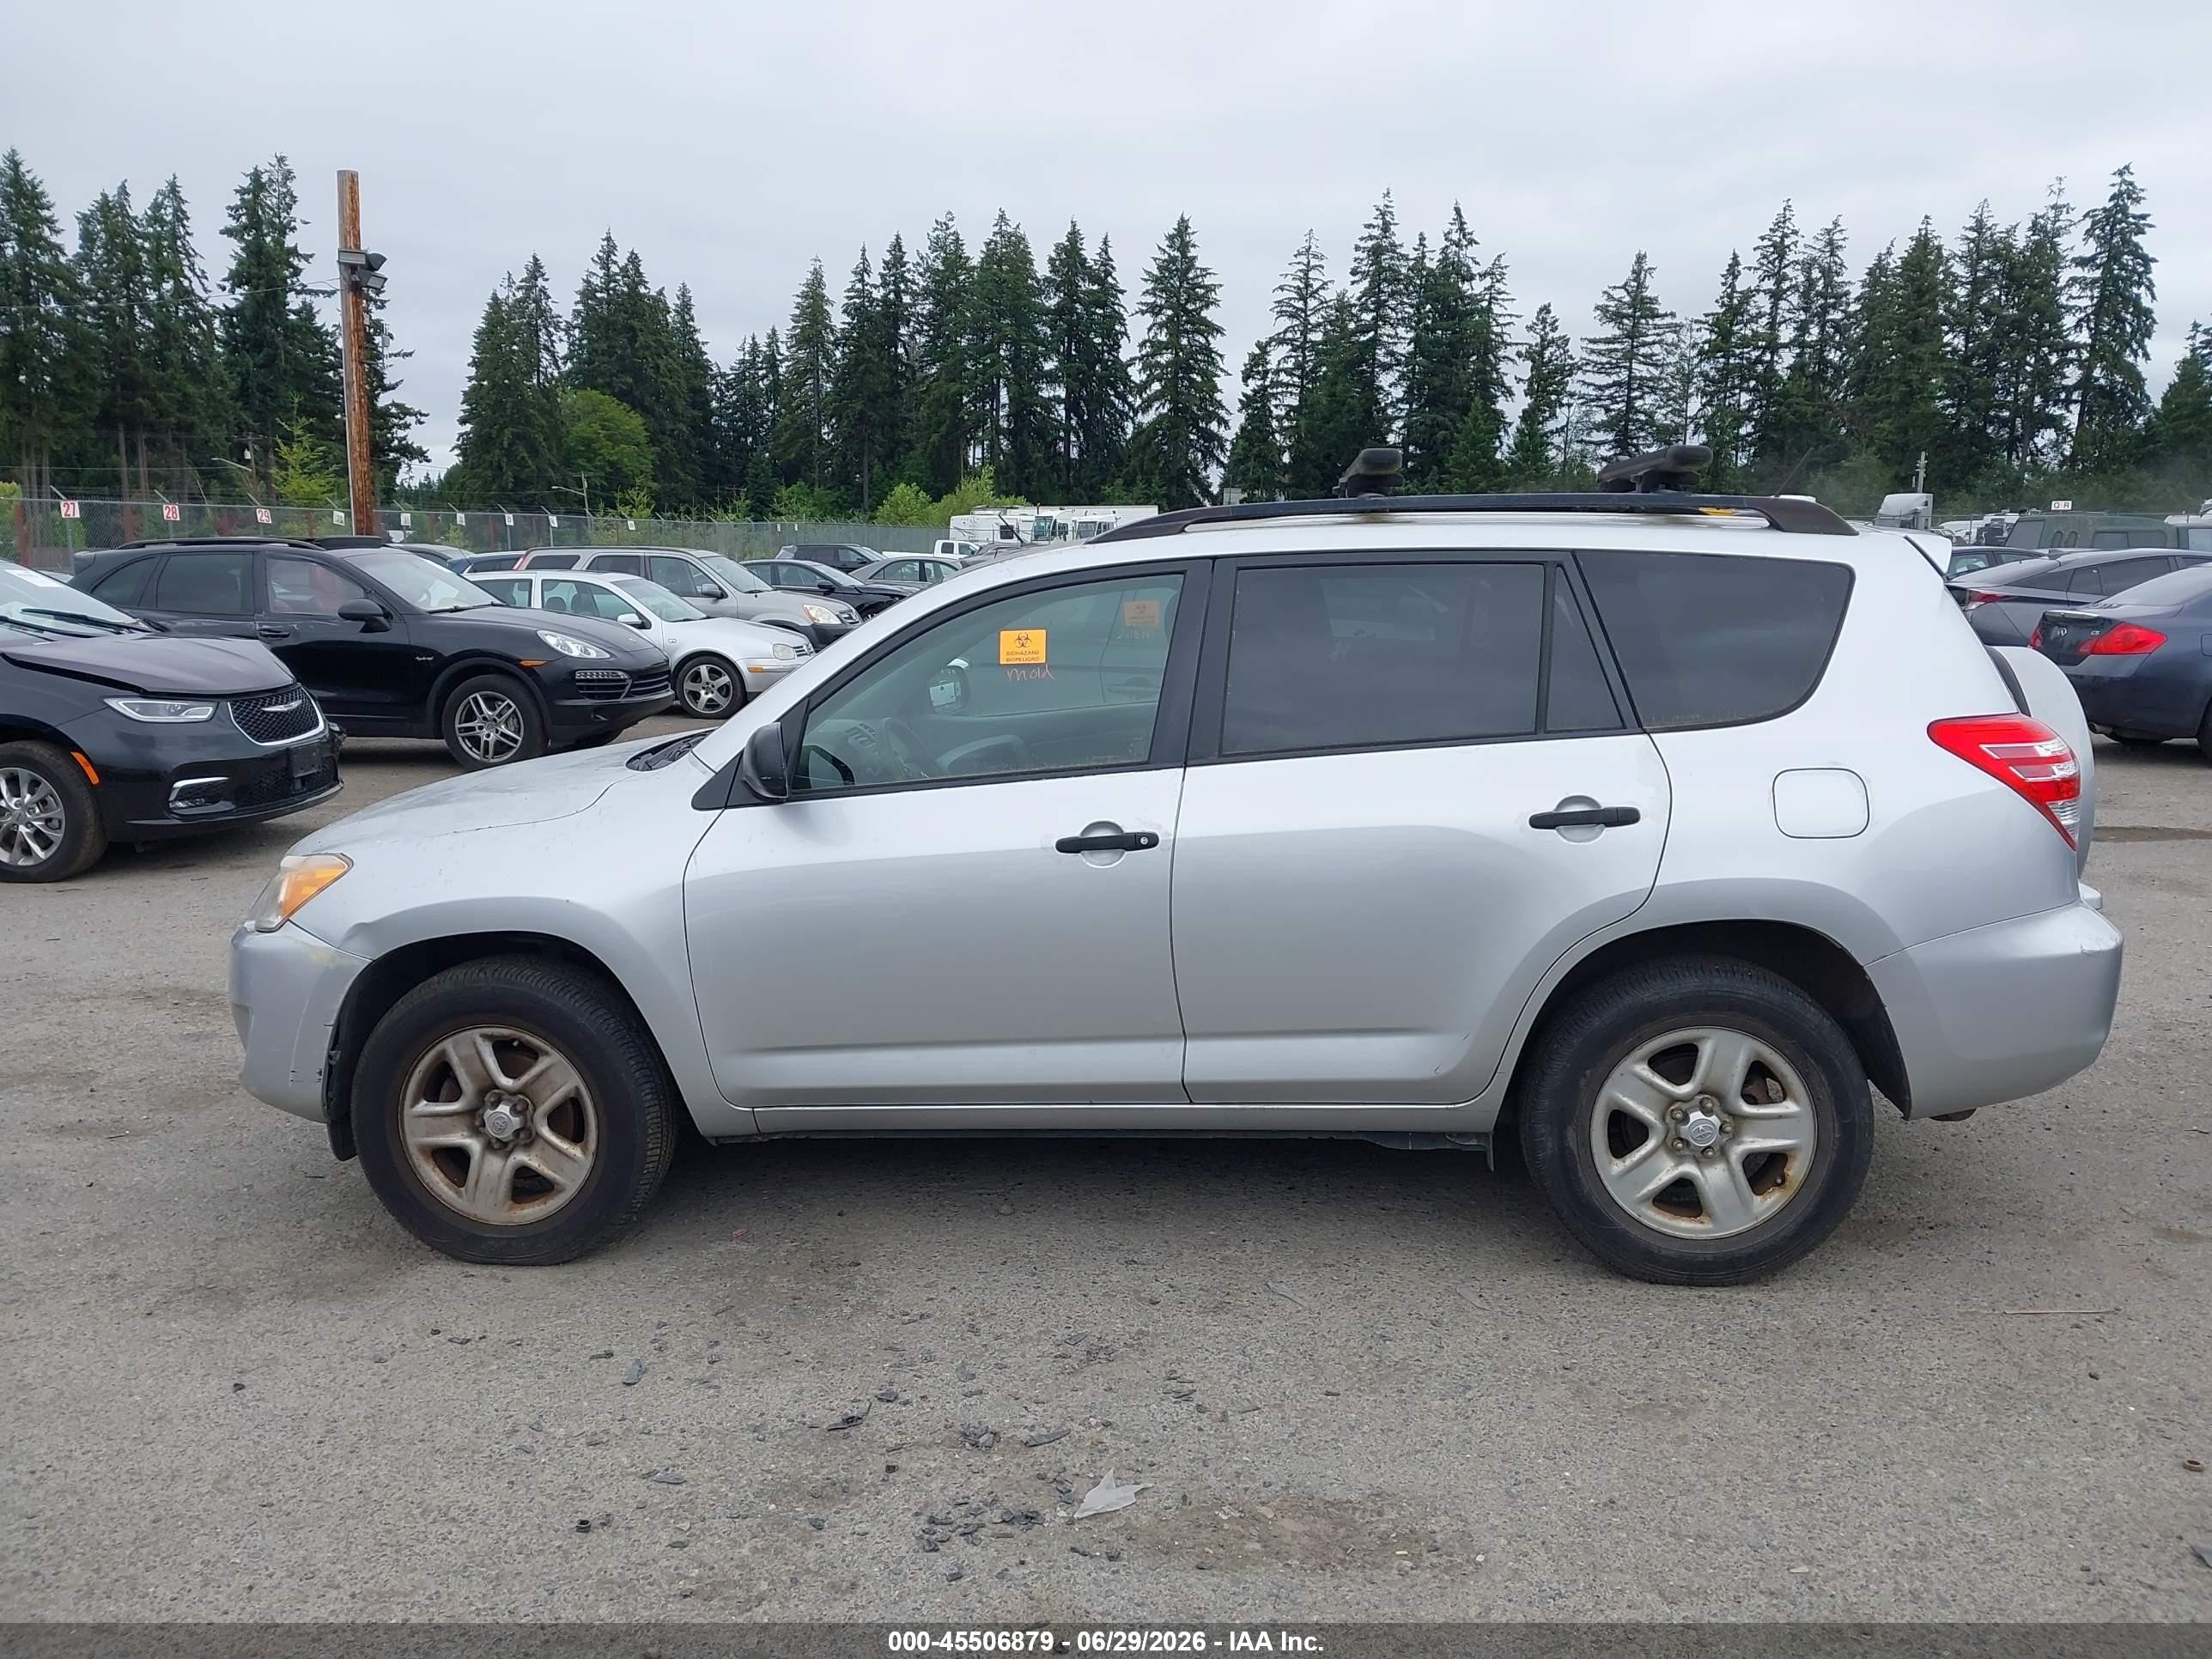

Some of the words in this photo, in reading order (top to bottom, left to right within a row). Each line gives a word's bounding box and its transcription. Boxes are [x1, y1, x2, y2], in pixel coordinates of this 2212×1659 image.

[63, 501, 76, 517] 27
[164, 505, 178, 520] 28
[258, 509, 270, 523] 29
